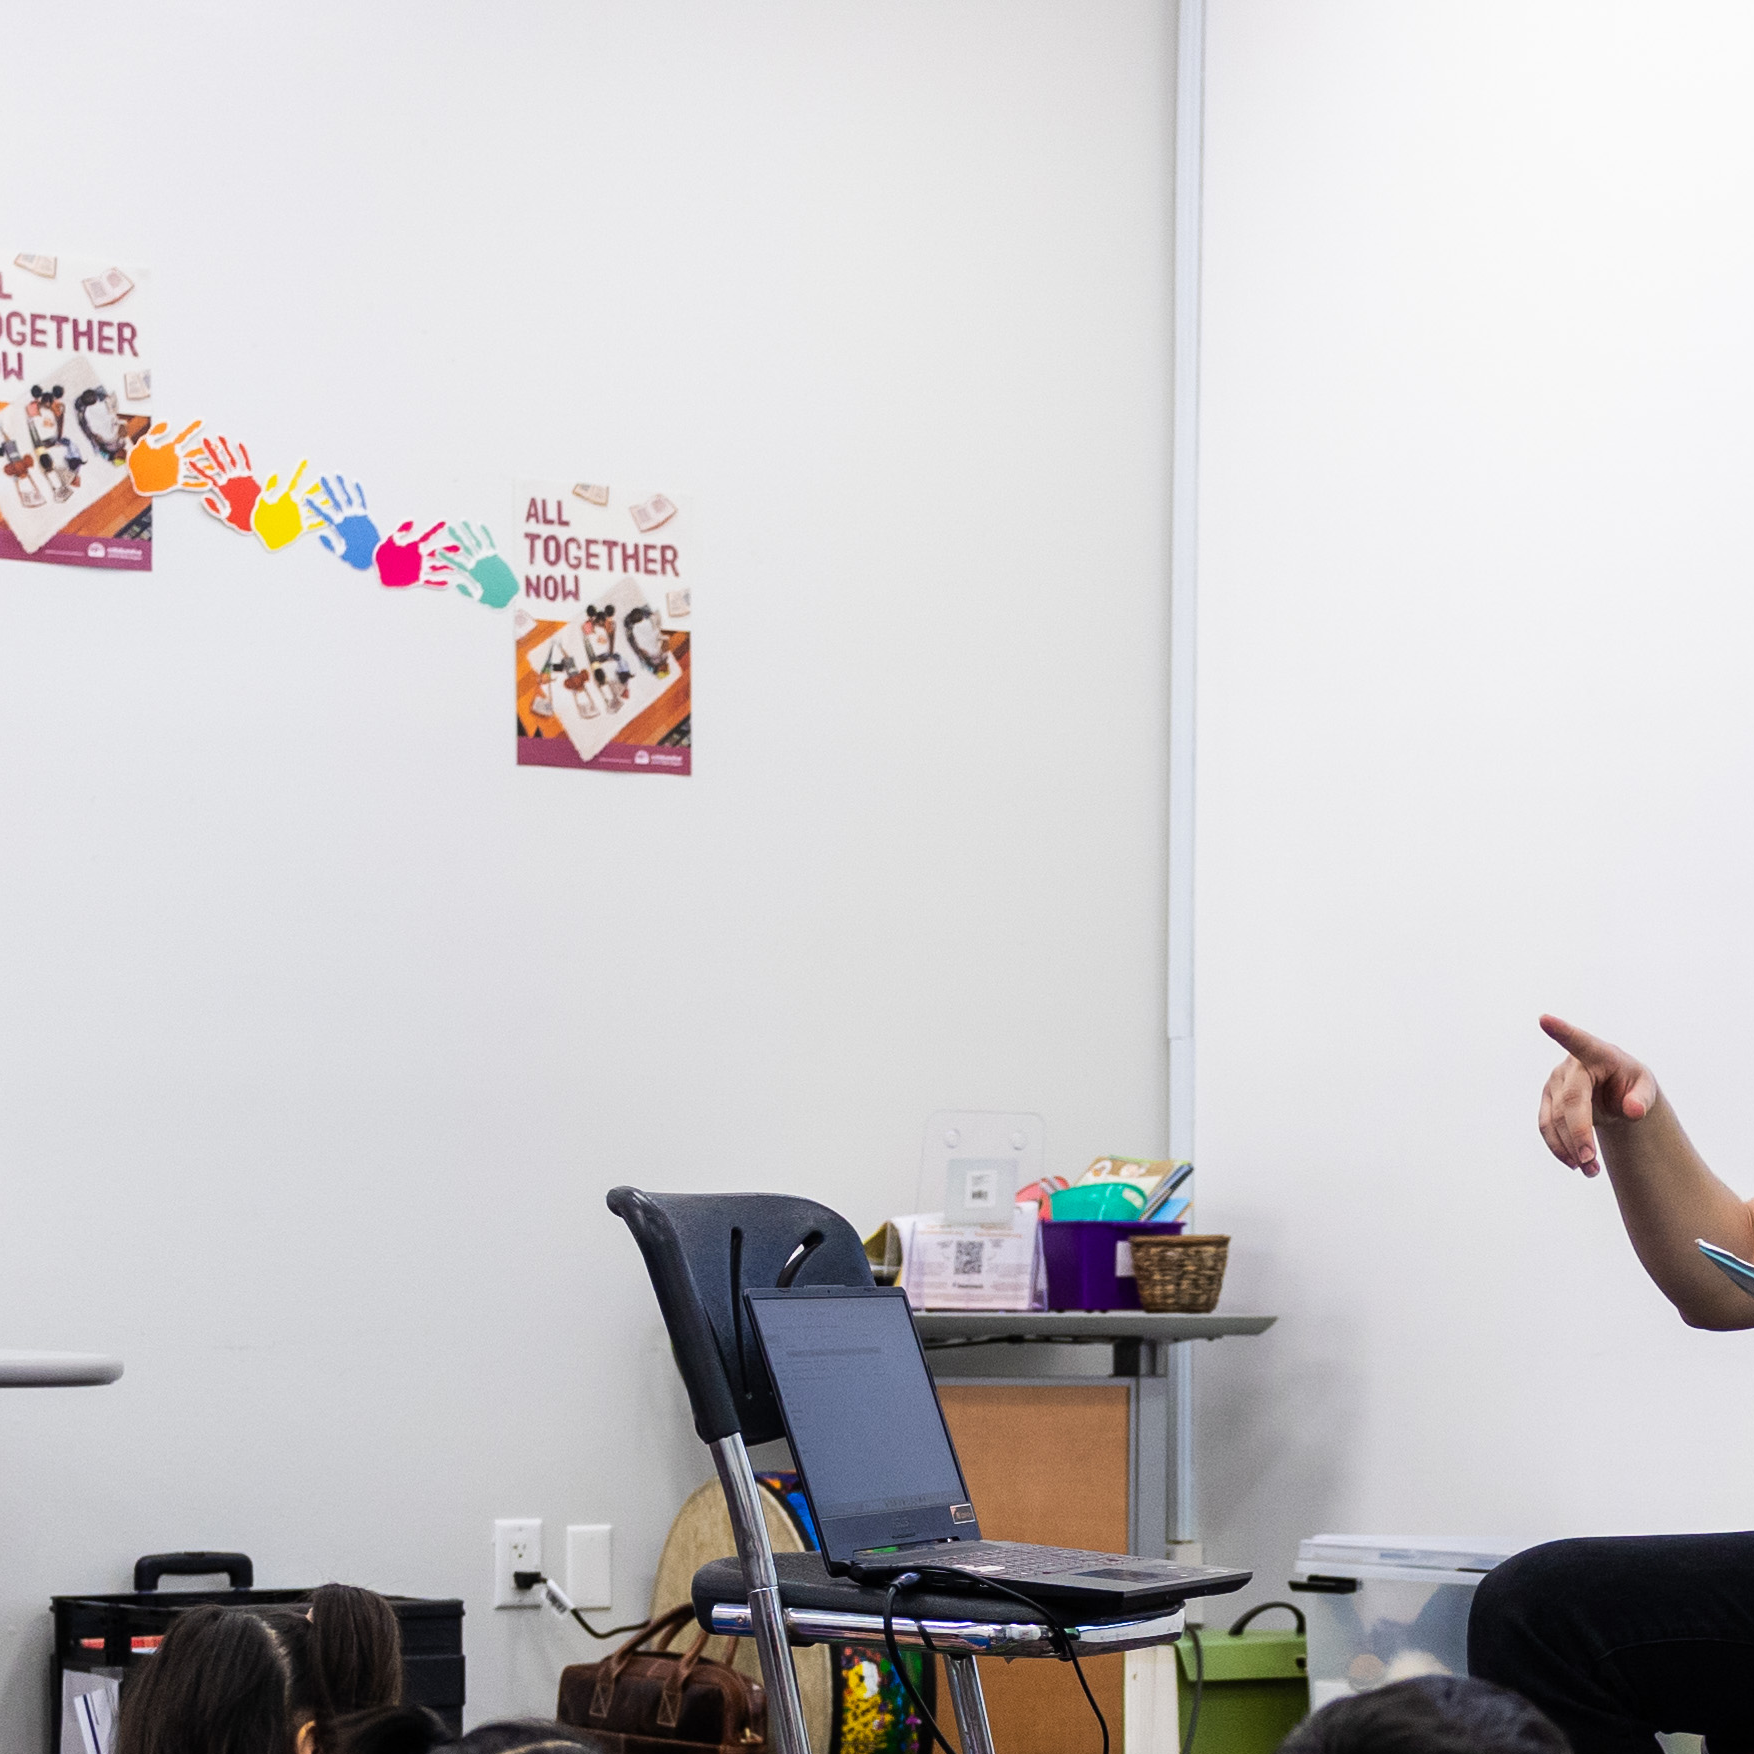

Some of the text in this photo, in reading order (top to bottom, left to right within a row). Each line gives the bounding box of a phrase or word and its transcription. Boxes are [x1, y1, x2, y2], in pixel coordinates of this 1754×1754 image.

[525, 497, 571, 527] ALL
[524, 532, 680, 578] TOGETHER
[525, 574, 581, 602] NOW
